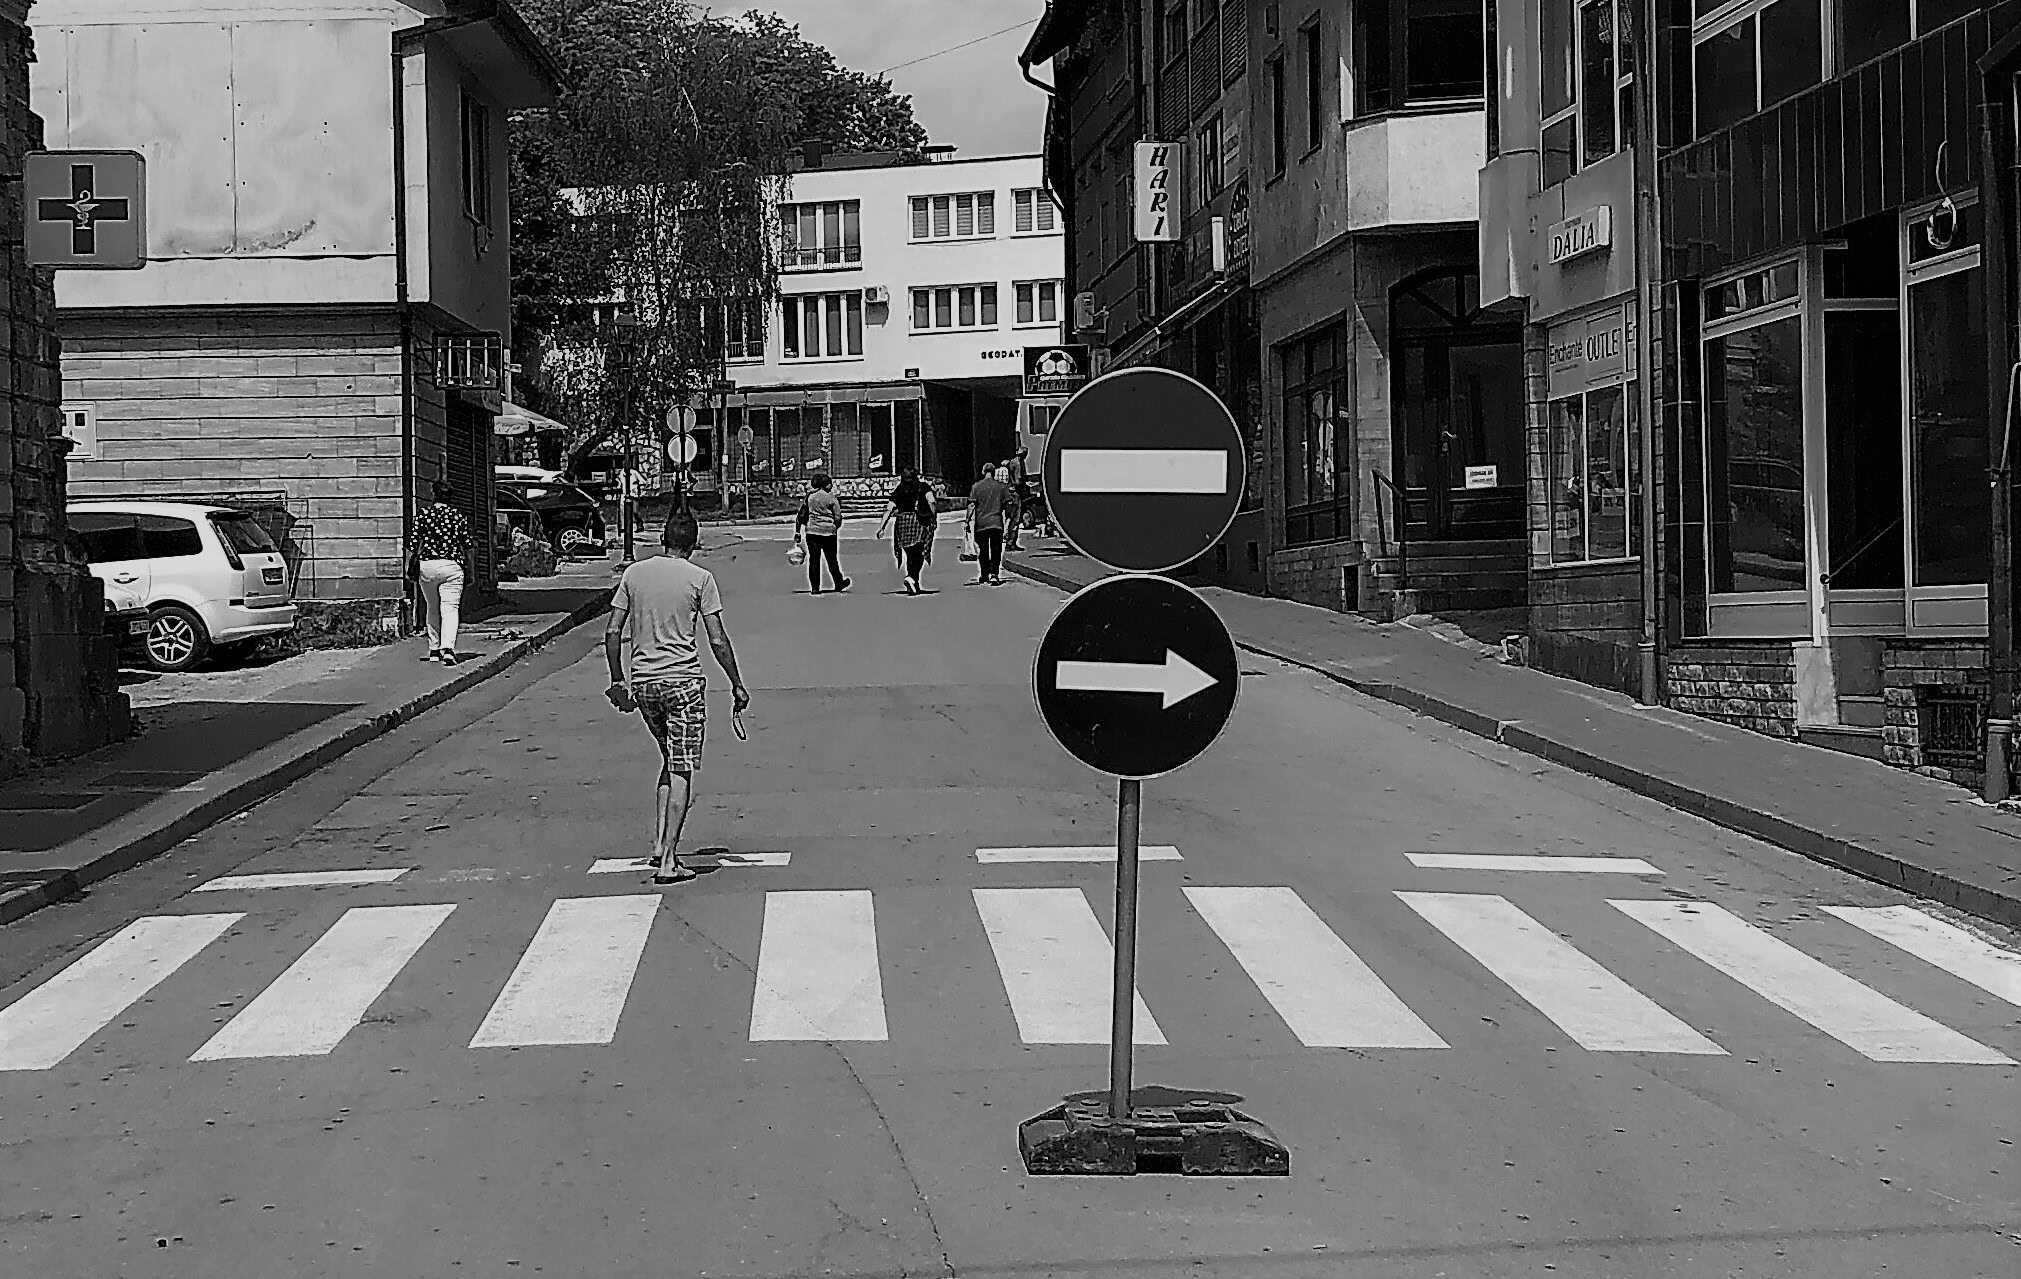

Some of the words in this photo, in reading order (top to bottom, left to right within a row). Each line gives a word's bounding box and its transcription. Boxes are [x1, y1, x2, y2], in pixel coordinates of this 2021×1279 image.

[1150, 146, 1169, 236] HARI
[1554, 222, 1595, 260] DALIA
[981, 350, 1023, 359] GEODAT
